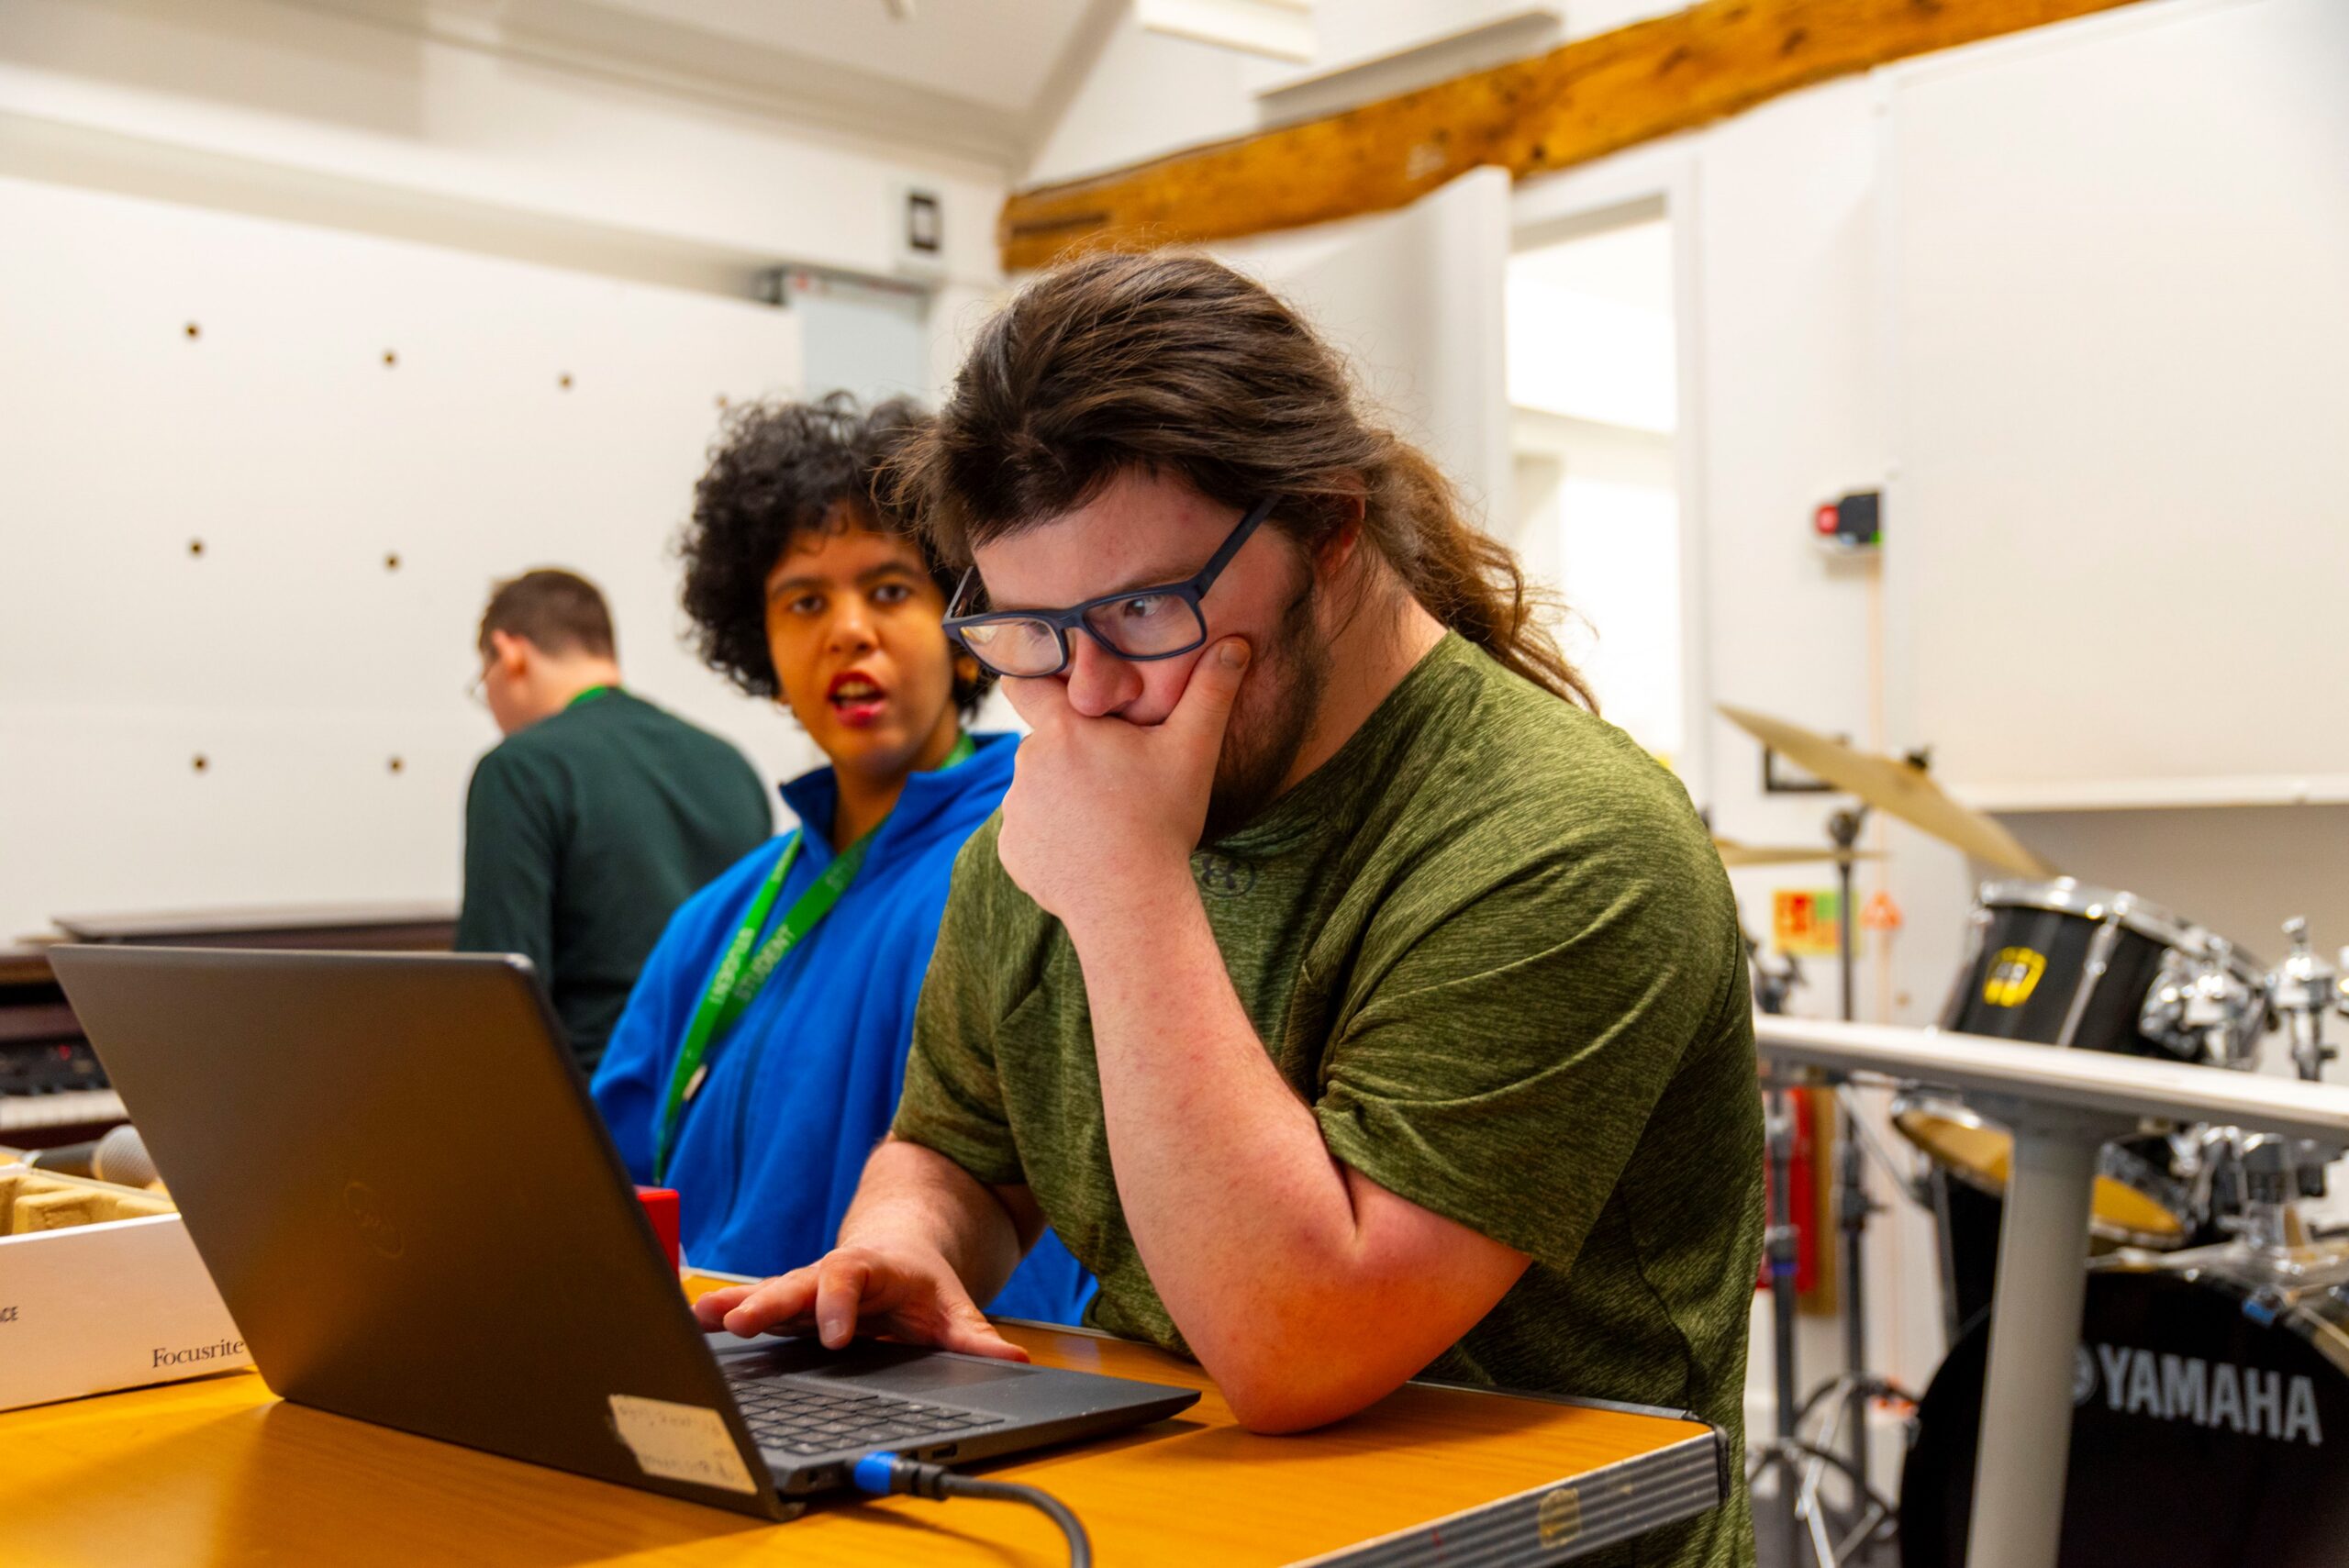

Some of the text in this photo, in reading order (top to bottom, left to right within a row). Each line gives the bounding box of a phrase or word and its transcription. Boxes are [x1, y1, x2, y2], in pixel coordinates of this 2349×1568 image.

[0, 1306, 18, 1323] CE
[151, 1338, 245, 1368] Focusrite
[2097, 1343, 2323, 1447] YAMAHA
